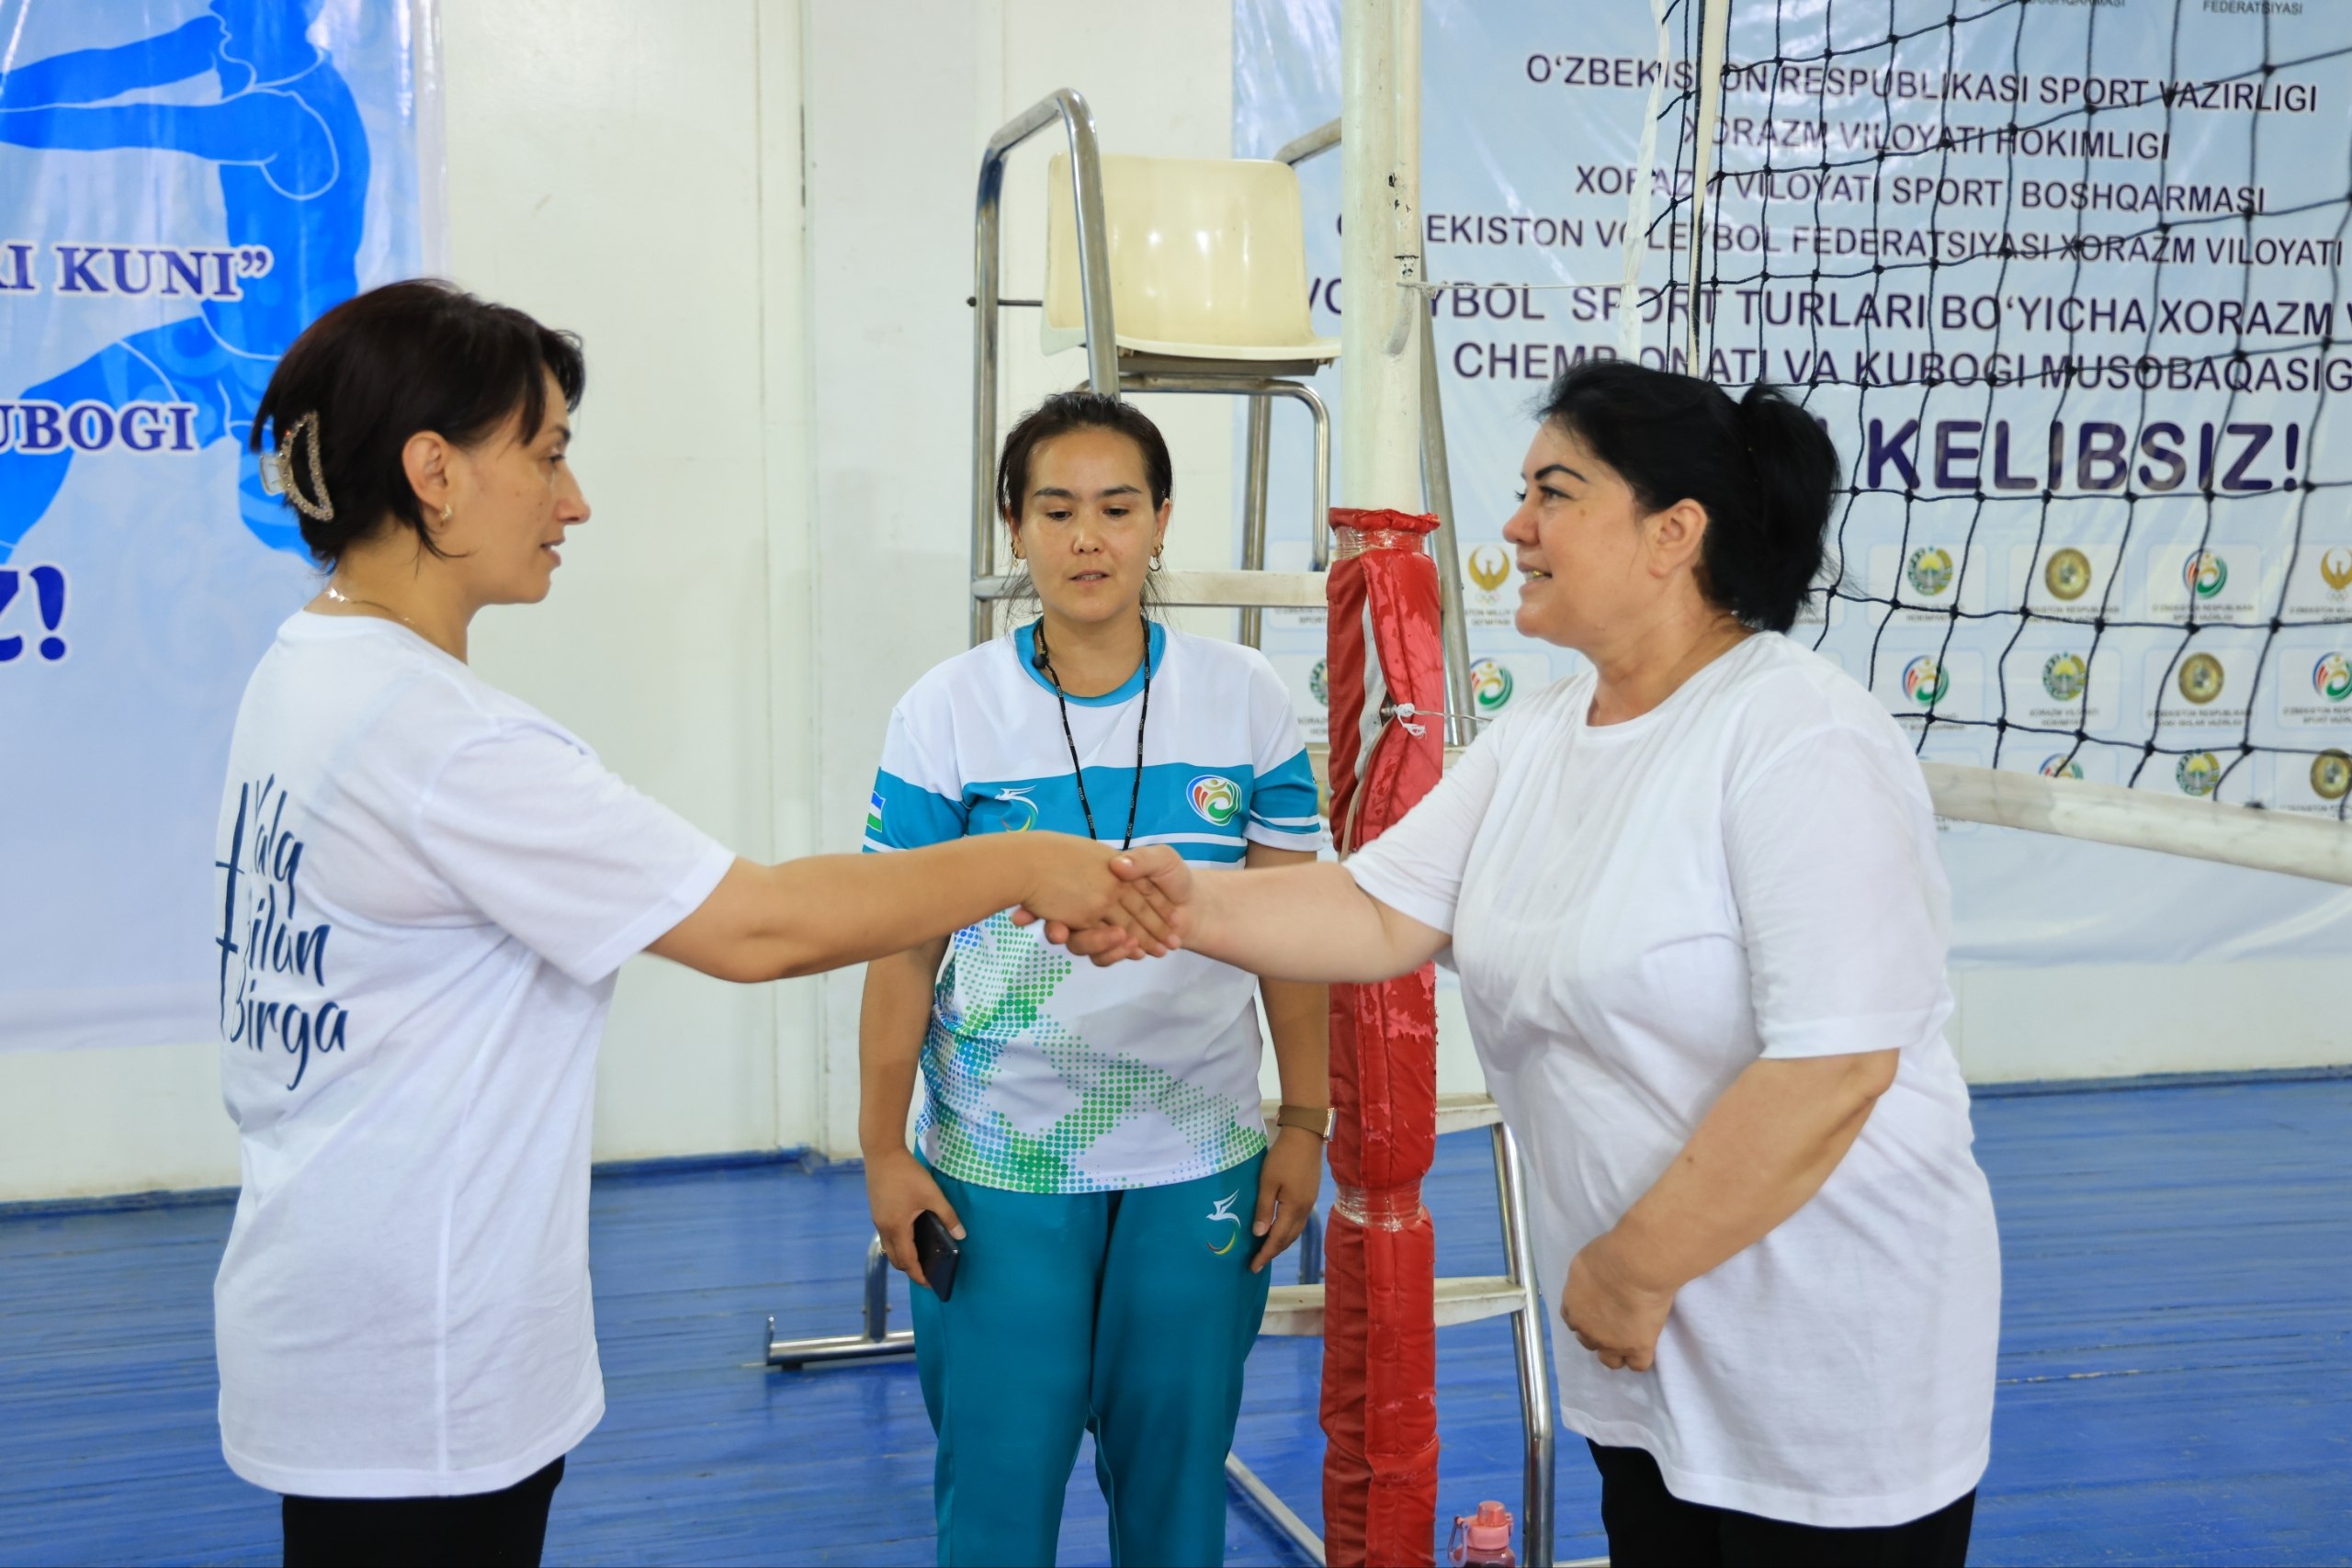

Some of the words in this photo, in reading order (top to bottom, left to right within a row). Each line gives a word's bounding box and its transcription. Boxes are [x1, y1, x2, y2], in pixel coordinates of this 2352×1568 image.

[1526, 53, 1766, 92] O‘ZBEKISON
[1781, 65, 2028, 102] RESPUBLIKASI
[2040, 76, 2149, 107] SPORT
[2160, 81, 2316, 112] VAZIRLIGI
[1840, 122, 1984, 154] VILOYATI
[1996, 128, 2170, 160] HOKIMLIGI
[1736, 171, 1880, 206] VILOYATI
[1892, 176, 2004, 208] SPORT
[2022, 181, 2266, 214] BOSHQARMASI
[1792, 226, 2050, 262] FEDERATSIYASI
[2059, 233, 2196, 265] XORAZM
[2206, 237, 2342, 268] VILOYATI
[1736, 288, 1926, 330] TURLARI
[2158, 299, 2333, 336] XORAZM
[1453, 342, 1765, 384] CHEMPONATI
[1784, 349, 1836, 384] VA
[1854, 352, 2025, 389] KUBOGI
[1867, 417, 2300, 492] KELIBSIZ!
